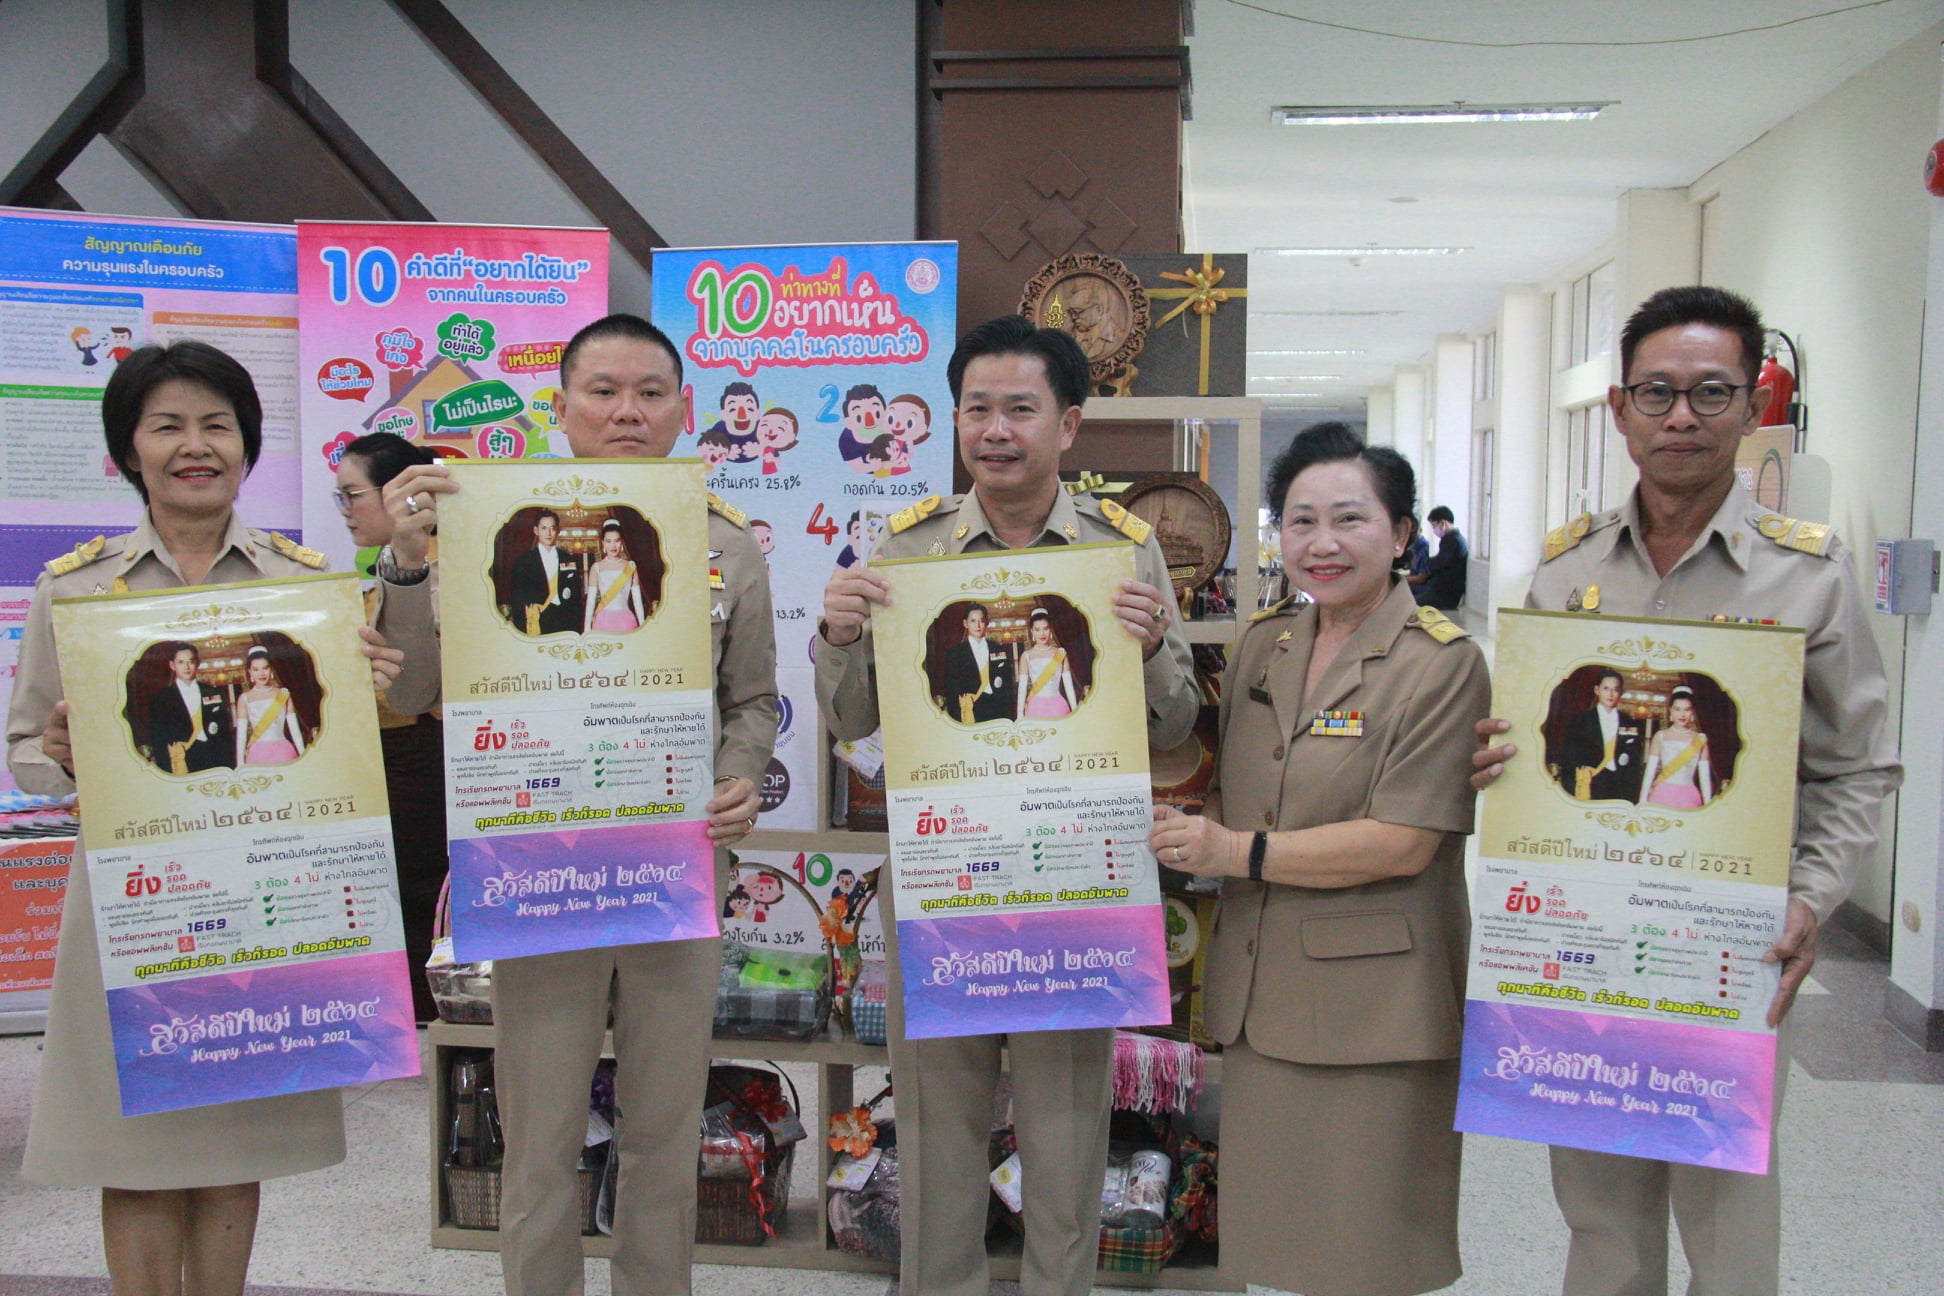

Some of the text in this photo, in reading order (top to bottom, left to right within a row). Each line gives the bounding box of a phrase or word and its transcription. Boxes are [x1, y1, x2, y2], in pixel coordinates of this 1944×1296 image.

[84, 235, 202, 256] สัญญาณเตือนภัย
[62, 258, 225, 280] ความรุนแรงในครอบครัว
[319, 247, 399, 305] 10
[427, 284, 568, 305] จากคนในครอบครัว
[693, 264, 841, 338] 10 ท่าทางที่
[774, 279, 896, 329] อยากเห็น
[381, 331, 416, 351] ภูมิใจ
[451, 325, 482, 342] ทำได้
[443, 337, 484, 357] อยู่แล้ว
[693, 324, 921, 364] จากบุคคลในครอบครัว
[385, 348, 408, 364] เก่ง
[507, 345, 563, 368] เหนื่อยไ
[330, 363, 361, 378] มีอะไร
[320, 375, 372, 392] ให้ช่วยไหม
[441, 394, 519, 421] ไม่เป็นไรนะ
[816, 383, 840, 423] 2
[376, 413, 414, 432] ขอโทษ
[706, 467, 801, 490] ะครื้นเครง 25.8%
[843, 481, 929, 497] กอดกัน 20.5%
[806, 502, 840, 546] 4
[775, 607, 806, 620] 13.2%
[468, 669, 684, 694] สวัสดีปีใหม่ ๒๕๖๔ 2021
[510, 718, 526, 729] เร็ว
[640, 723, 705, 734] และรักษาให้หายได้
[472, 719, 507, 751] ยิ่ง
[511, 731, 529, 739] รอด
[511, 738, 549, 749] ปลอดภัย
[588, 743, 593, 751] 3
[598, 740, 618, 751] ต้อง
[623, 741, 628, 749] 4
[633, 738, 645, 748] ไม่
[907, 754, 1119, 781] สวัสดีปีใหม่ ๒๕๖๔ 2021
[525, 777, 560, 789] 1669
[475, 799, 684, 831] ทุกนาทีคือชีวิต เร็วก็รอด ปลอดอัมพาต
[949, 804, 964, 814] เร็ว
[1077, 807, 1145, 819] และรักษาให้หายได้
[112, 800, 356, 840] สวัสดีปีใหม่ ๒๕๖๔ 2021
[913, 804, 947, 835] ยิ่ง
[950, 816, 968, 824] รอด
[951, 823, 988, 834] ปลอดภัย
[1026, 828, 1032, 836] 3
[1036, 824, 1056, 835] ต้อง
[1071, 822, 1083, 833] ไม่
[310, 851, 386, 868] และรักษาให้หายได้
[1507, 832, 1752, 875] สวัสดีปีใหม่ ๒๕๖๔ 2021
[163, 860, 182, 872] เร็ว
[792, 852, 833, 887] 10
[966, 860, 1001, 872] 1669
[121, 862, 163, 897] ยิ่ง
[165, 873, 186, 882] รอด
[166, 879, 210, 893] ปลอดภัย
[254, 881, 261, 889] 3
[265, 875, 288, 888] ต้อง
[293, 876, 300, 884] 4
[305, 871, 319, 883] ไม่
[470, 860, 687, 907] สวัสดีปีใหม่ ๒๕๖๔
[921, 884, 1129, 912] ทุกนาทีคือชีวิต เร็วก็รอด ปลอดอัมพาต
[1505, 879, 1542, 915] ยิ่ง
[1546, 884, 1564, 896] เร็ว
[516, 892, 658, 917] Happy New Year 2021
[1546, 897, 1566, 907] รอด
[1545, 906, 1587, 920] ปลอดภัย
[1693, 914, 1773, 932] และรักษาให้หายได้
[186, 917, 227, 932] 1669
[1630, 924, 1637, 933] 3
[1642, 923, 1666, 936] ต้อง
[1671, 928, 1678, 936] 4
[1684, 927, 1698, 939] ไม่
[773, 931, 805, 945] 3.2%
[134, 951, 226, 979] ทุกนาทีคือชีวิต
[229, 942, 287, 963] เร็วก็รอด
[291, 931, 371, 954] ปลอดอัมพาต
[1555, 949, 1595, 965] 1669
[919, 946, 1137, 986] สวัสดีปีใหม่ ๒๕๖๔
[964, 976, 1107, 997] Happy New Year 2021
[1497, 977, 1586, 1006] ทุกนาทีคือชีวิต
[1591, 987, 1649, 1010] เร็วก็รอด
[1655, 995, 1739, 1021] ปลอดอัมพาต
[135, 995, 383, 1058] สวัสดีปีใหม่ ๒๕๖๔
[189, 1029, 351, 1065] Happy New Year 2021
[1484, 1044, 1737, 1101] สวัสดีปีใหม่ ๒๕๖๔
[1529, 1081, 1697, 1117] Happy New Year 2021
